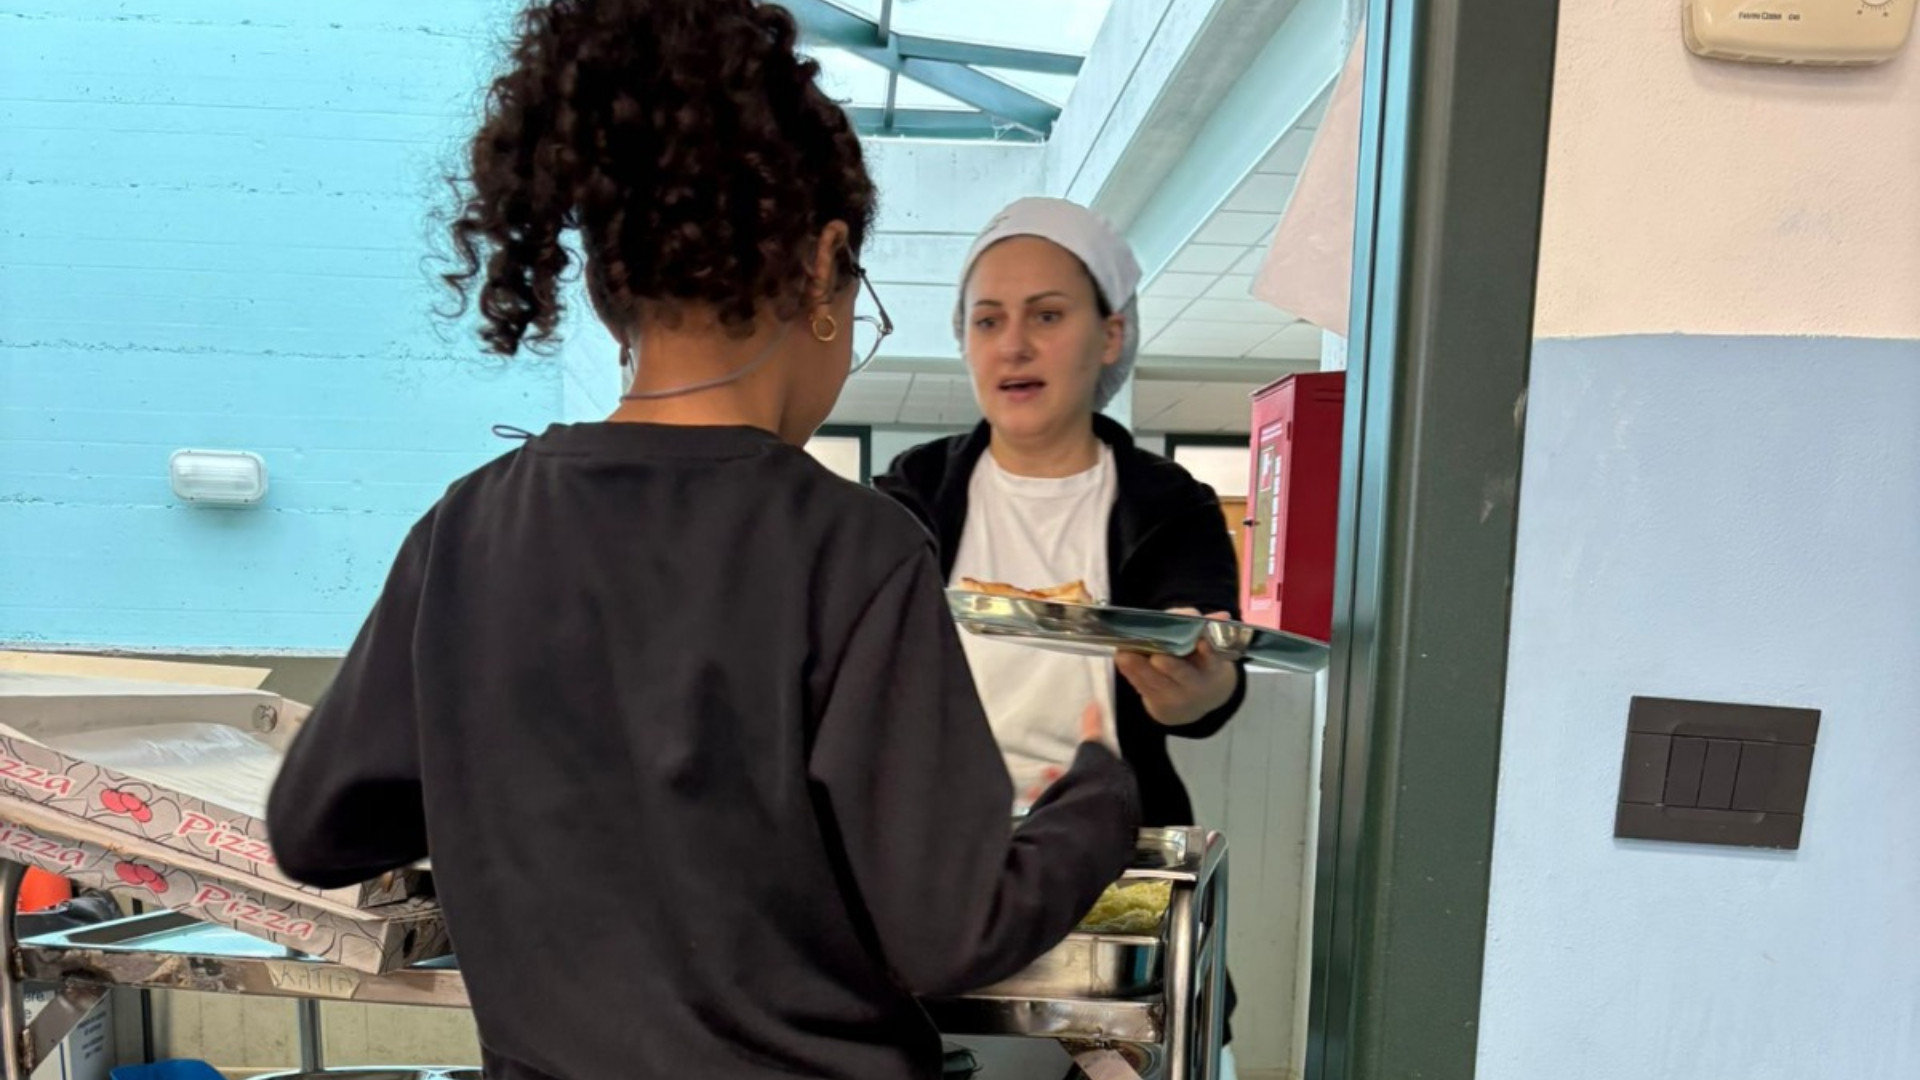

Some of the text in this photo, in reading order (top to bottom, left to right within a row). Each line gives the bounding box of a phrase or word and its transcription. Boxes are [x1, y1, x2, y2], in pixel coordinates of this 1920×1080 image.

[0, 749, 71, 795] zza
[0, 822, 85, 866] izza
[177, 811, 277, 864] Pizz
[193, 883, 314, 938] Pizza
